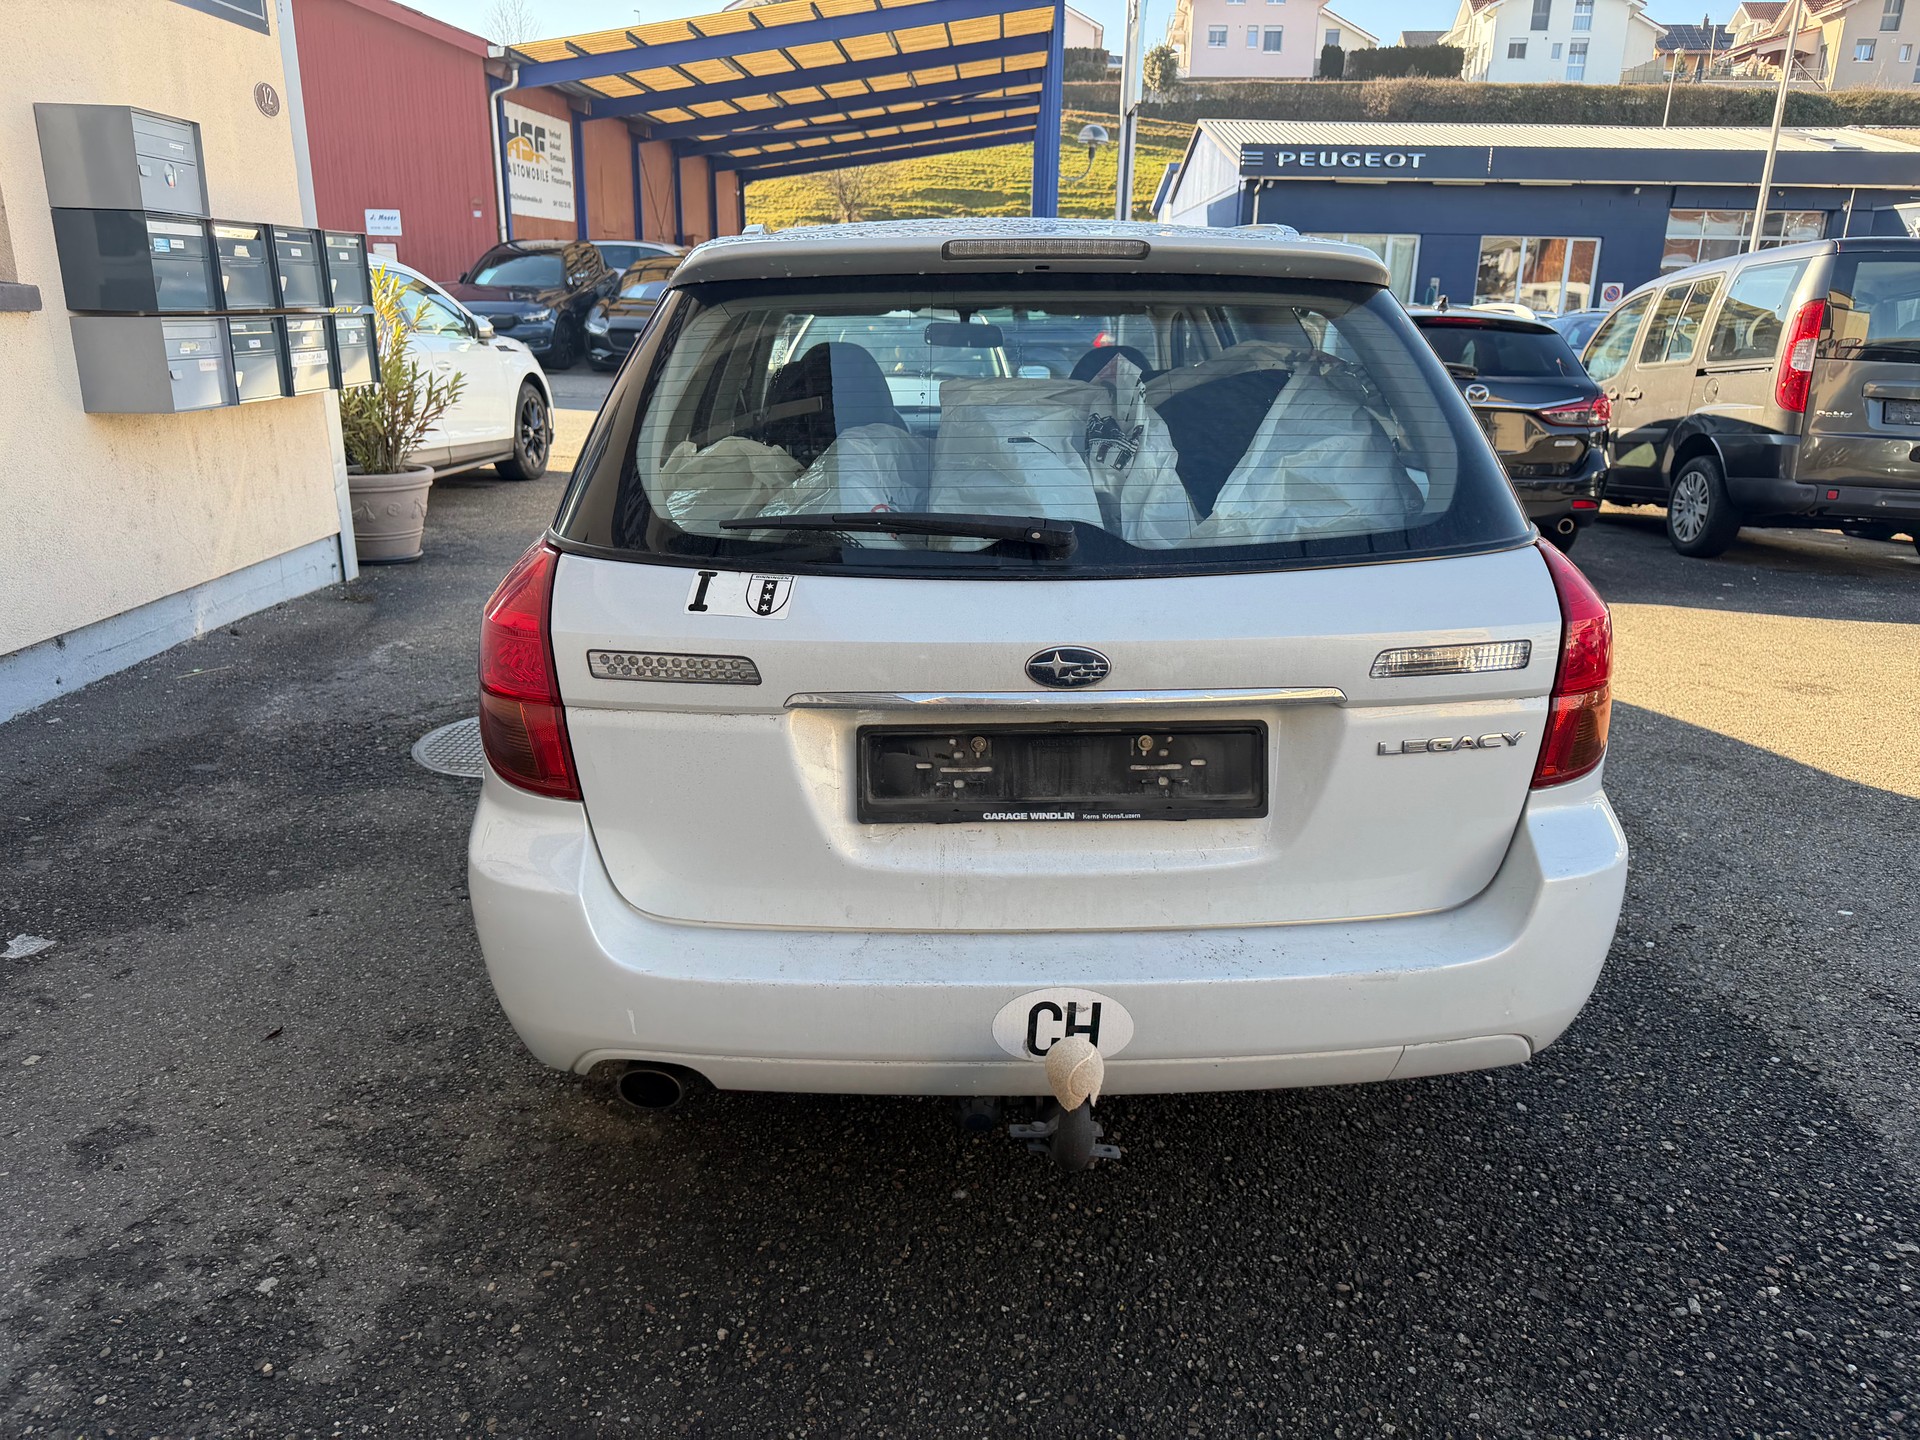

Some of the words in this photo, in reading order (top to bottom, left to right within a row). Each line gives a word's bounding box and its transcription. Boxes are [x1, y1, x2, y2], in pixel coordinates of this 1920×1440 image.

[262, 86, 273, 105] 12
[1275, 150, 1427, 169] PEUGEOT
[688, 571, 718, 612] I
[1377, 731, 1527, 756] LEGACY
[983, 812, 1028, 820] GARAGE
[1029, 812, 1075, 820] WINDLIN
[1102, 812, 1141, 820] Kriens/Luzern
[1027, 1001, 1102, 1056] CH
